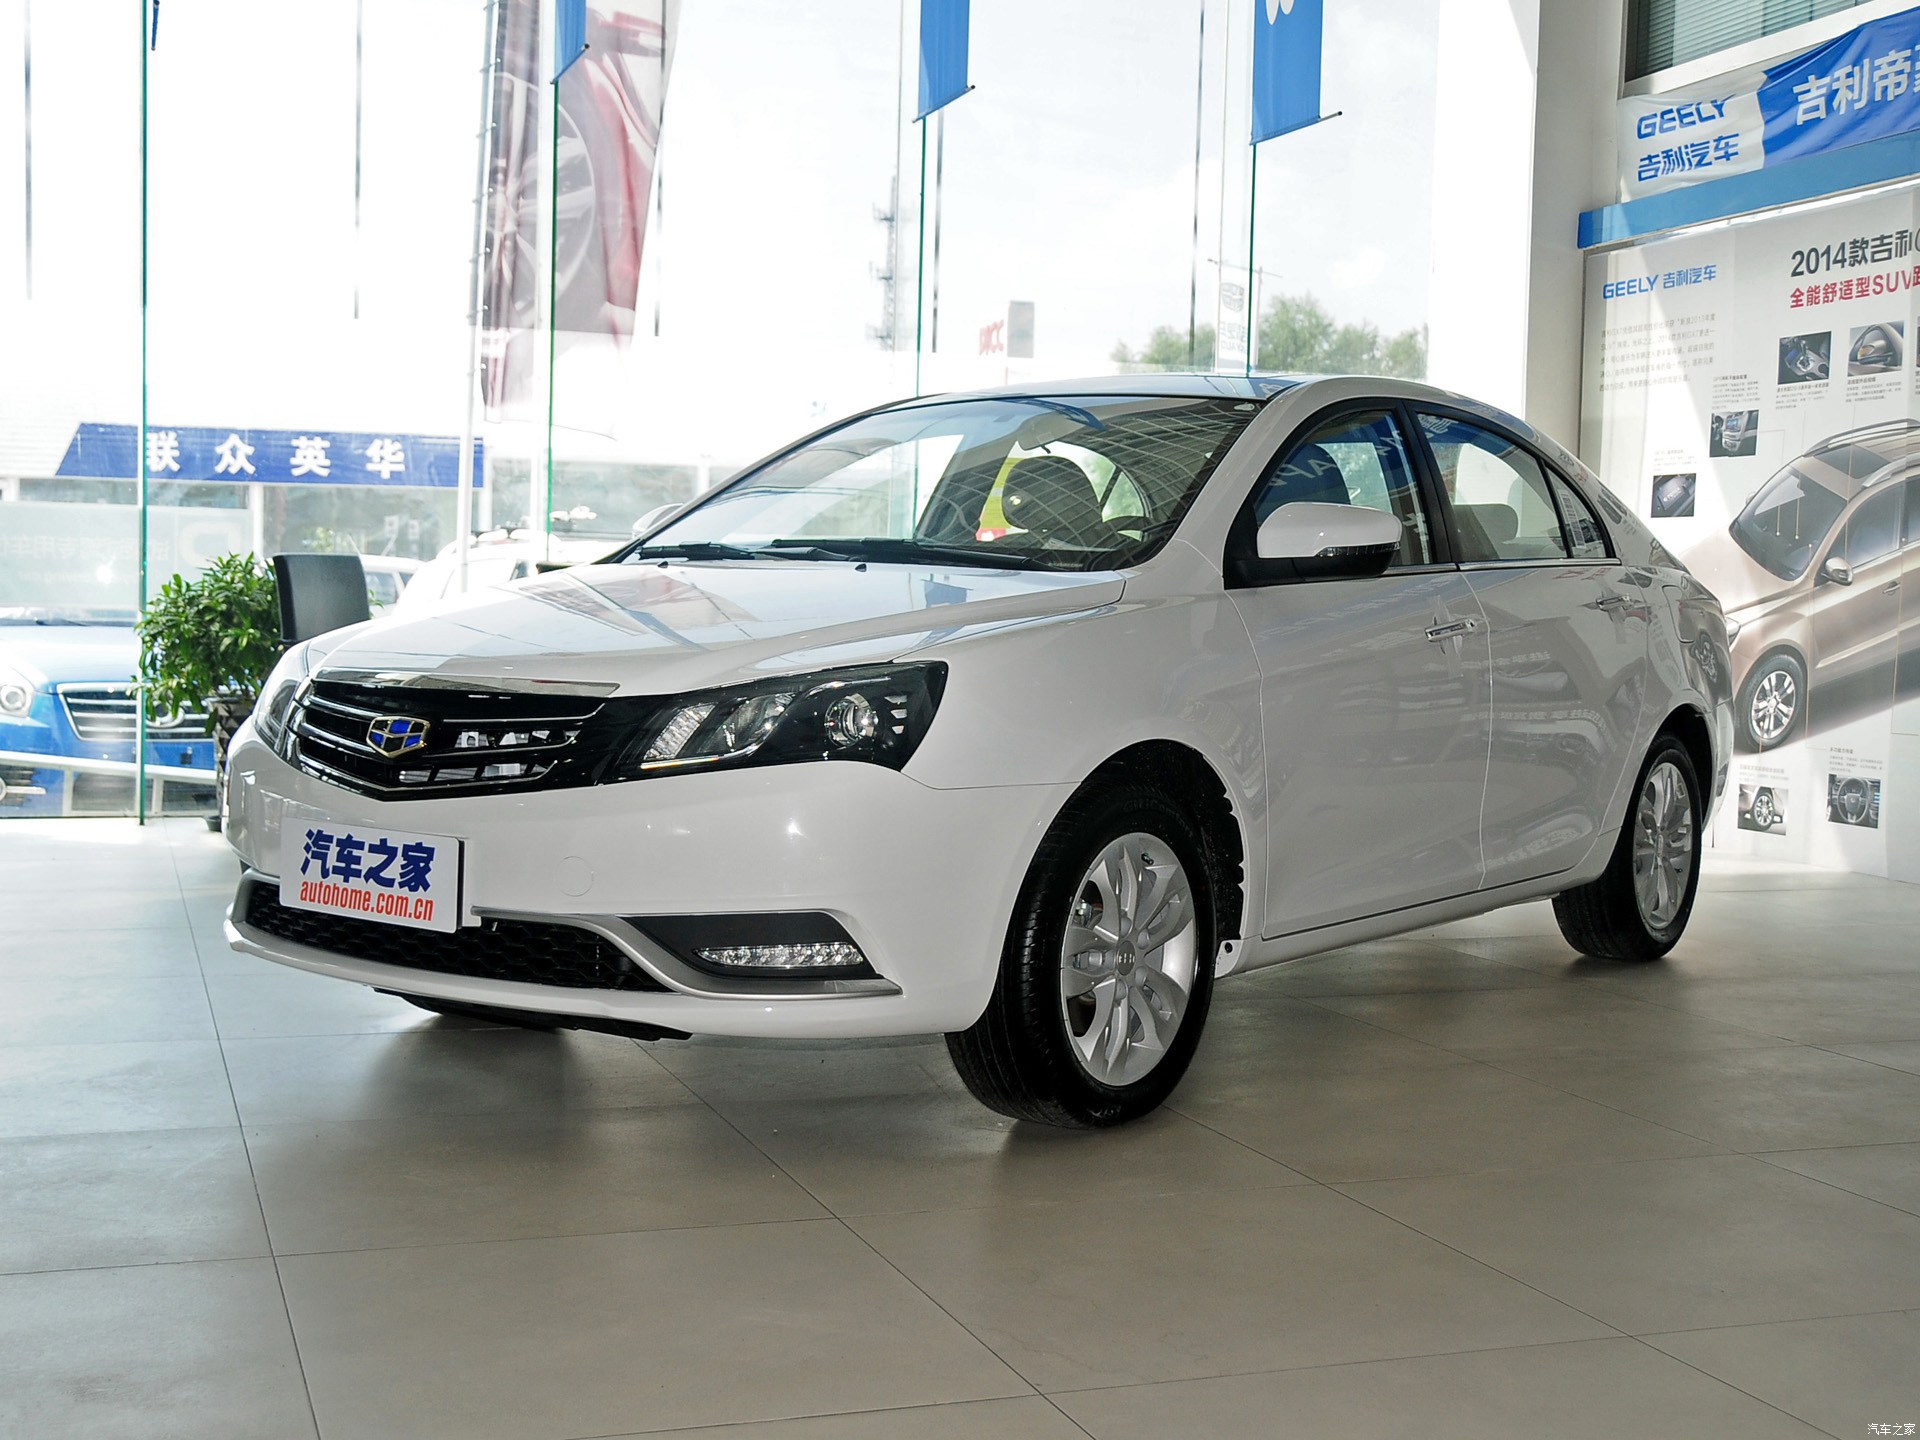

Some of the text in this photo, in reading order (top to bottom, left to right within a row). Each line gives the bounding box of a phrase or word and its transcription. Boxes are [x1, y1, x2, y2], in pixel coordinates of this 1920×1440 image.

[1793, 44, 1920, 126] 吉利帝
[1637, 94, 1736, 140] GEELY
[1638, 133, 1739, 182] 吉利汽车
[1603, 265, 1717, 300] GEELY 吉利汽车
[146, 431, 406, 480] 联众英华
[301, 828, 436, 892] 汽车之家
[300, 880, 434, 922] autohome.com.cn
